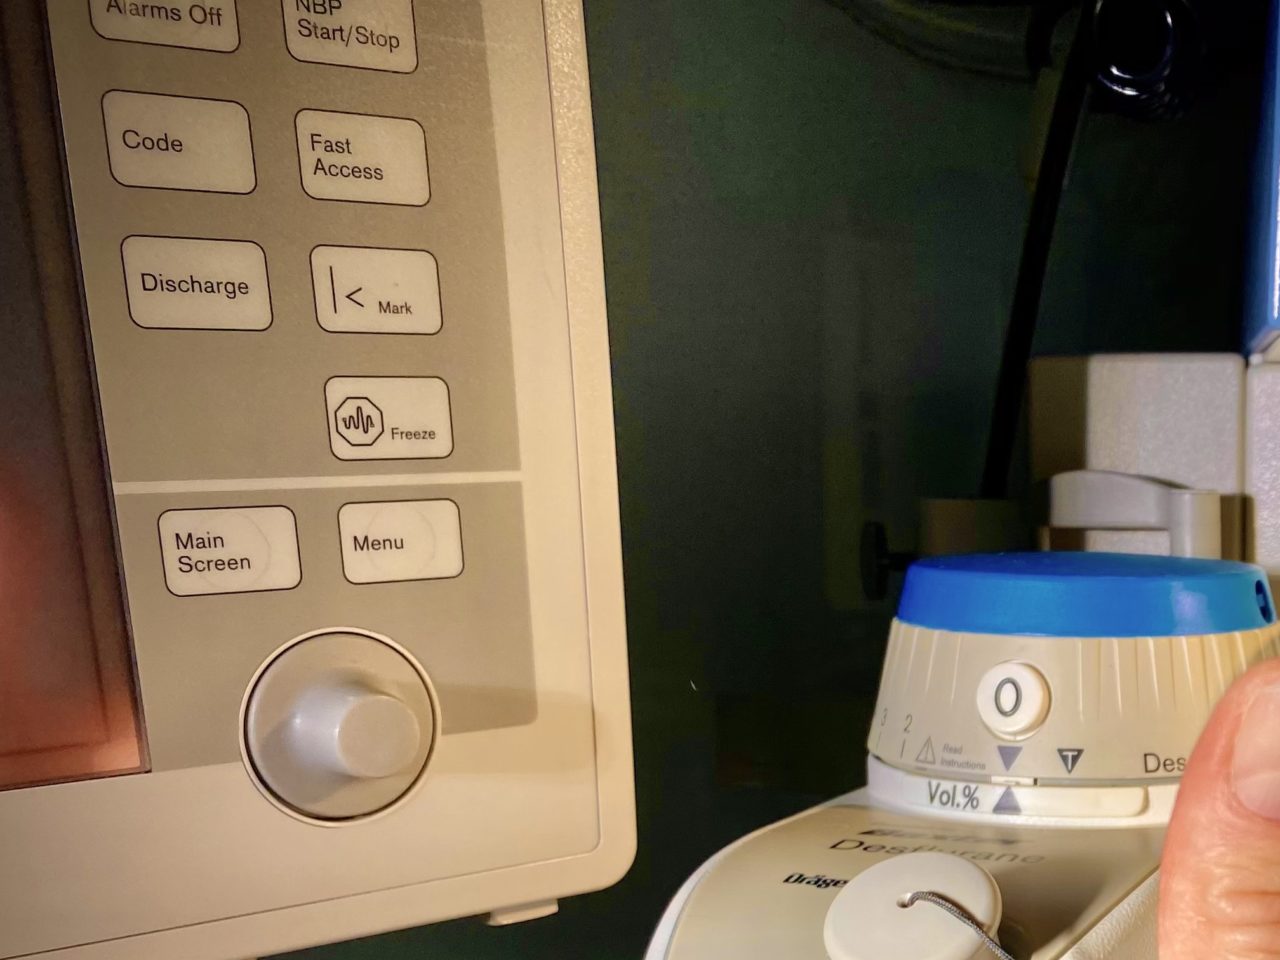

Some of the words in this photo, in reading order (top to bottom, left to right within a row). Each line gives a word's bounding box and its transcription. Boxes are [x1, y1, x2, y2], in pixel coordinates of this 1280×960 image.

[106, 0, 181, 21] Alarms
[189, 4, 223, 26] Off
[296, 0, 342, 15] NBP
[298, 19, 400, 52] Start/Stop
[122, 130, 183, 153] Code
[310, 133, 352, 155] Fast
[313, 158, 384, 181] Access
[141, 272, 249, 299] Discharge
[378, 300, 413, 316] Mark
[391, 426, 436, 441] Freeze
[175, 532, 225, 551] Main
[353, 534, 404, 553] Menu
[178, 555, 251, 575] Screen
[904, 714, 913, 733] 2
